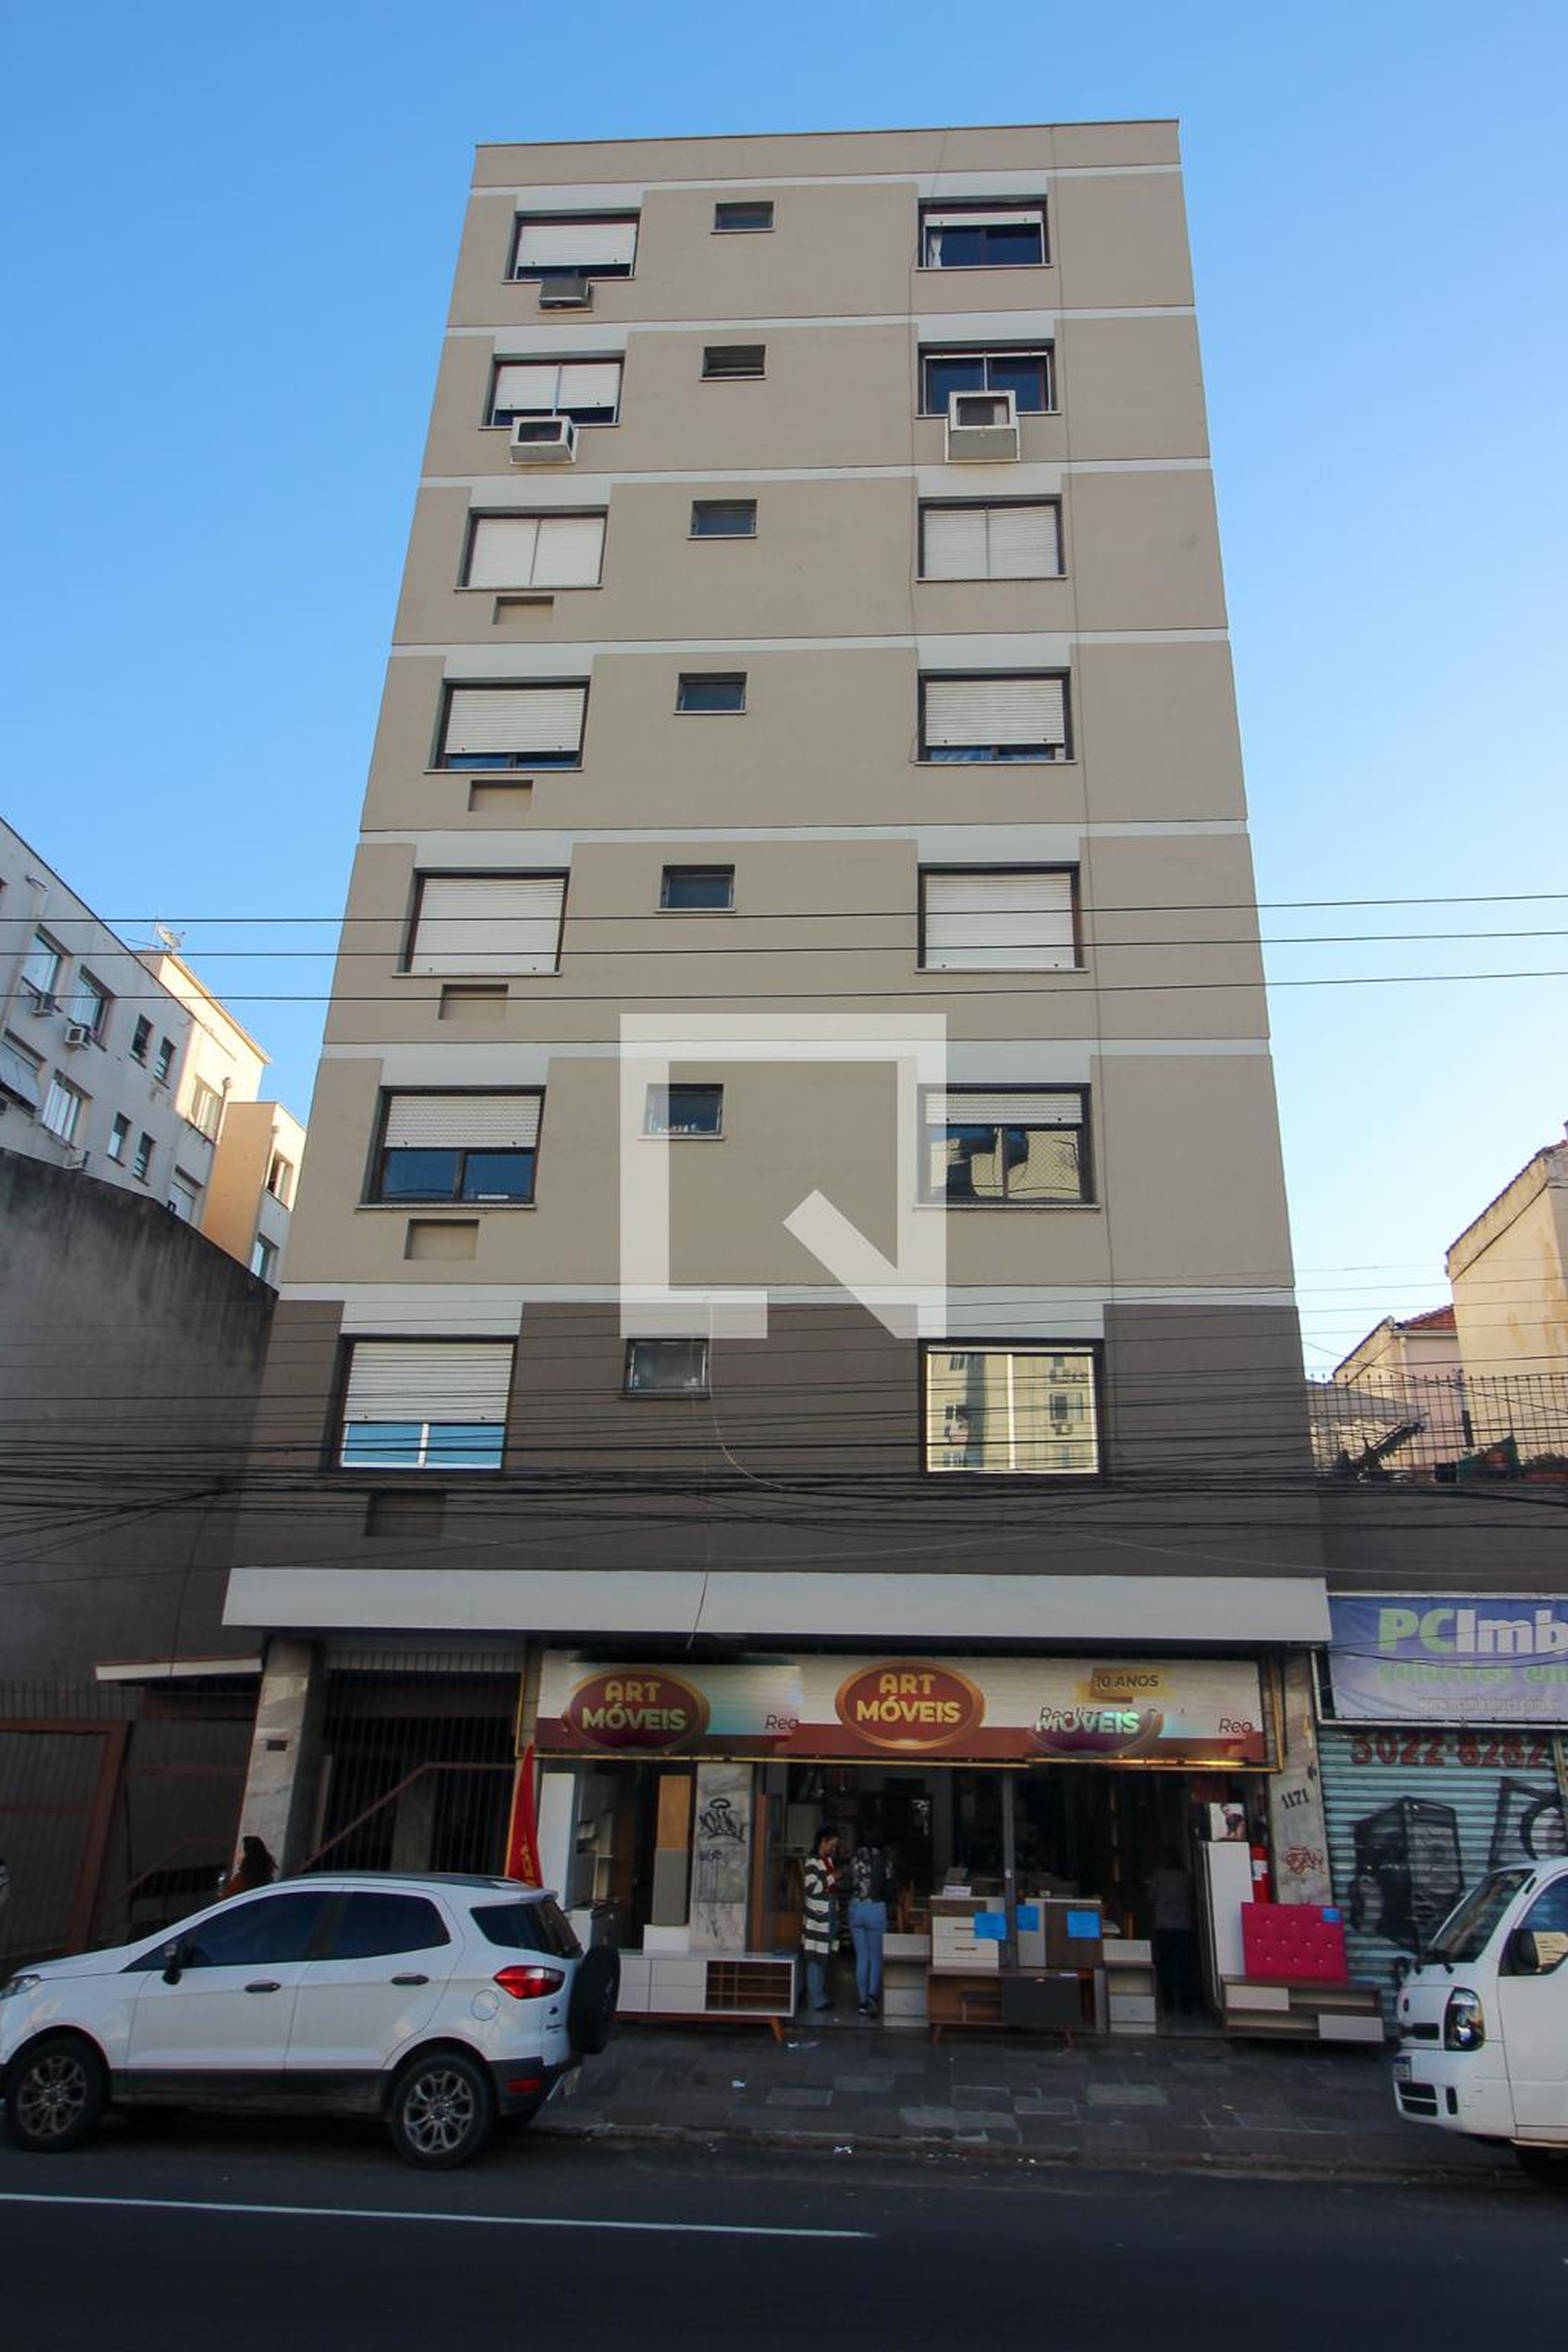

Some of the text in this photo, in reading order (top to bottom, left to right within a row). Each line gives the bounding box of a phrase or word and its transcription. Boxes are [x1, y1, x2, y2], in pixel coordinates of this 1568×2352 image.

[605, 1680, 662, 1702] ART
[880, 1673, 936, 1694] ART
[1114, 1675, 1158, 1687] ANOS
[581, 1702, 686, 1731] MÓVEIS
[857, 1696, 962, 1723] MÓVEIS
[1281, 1788, 1309, 1809] 1171
